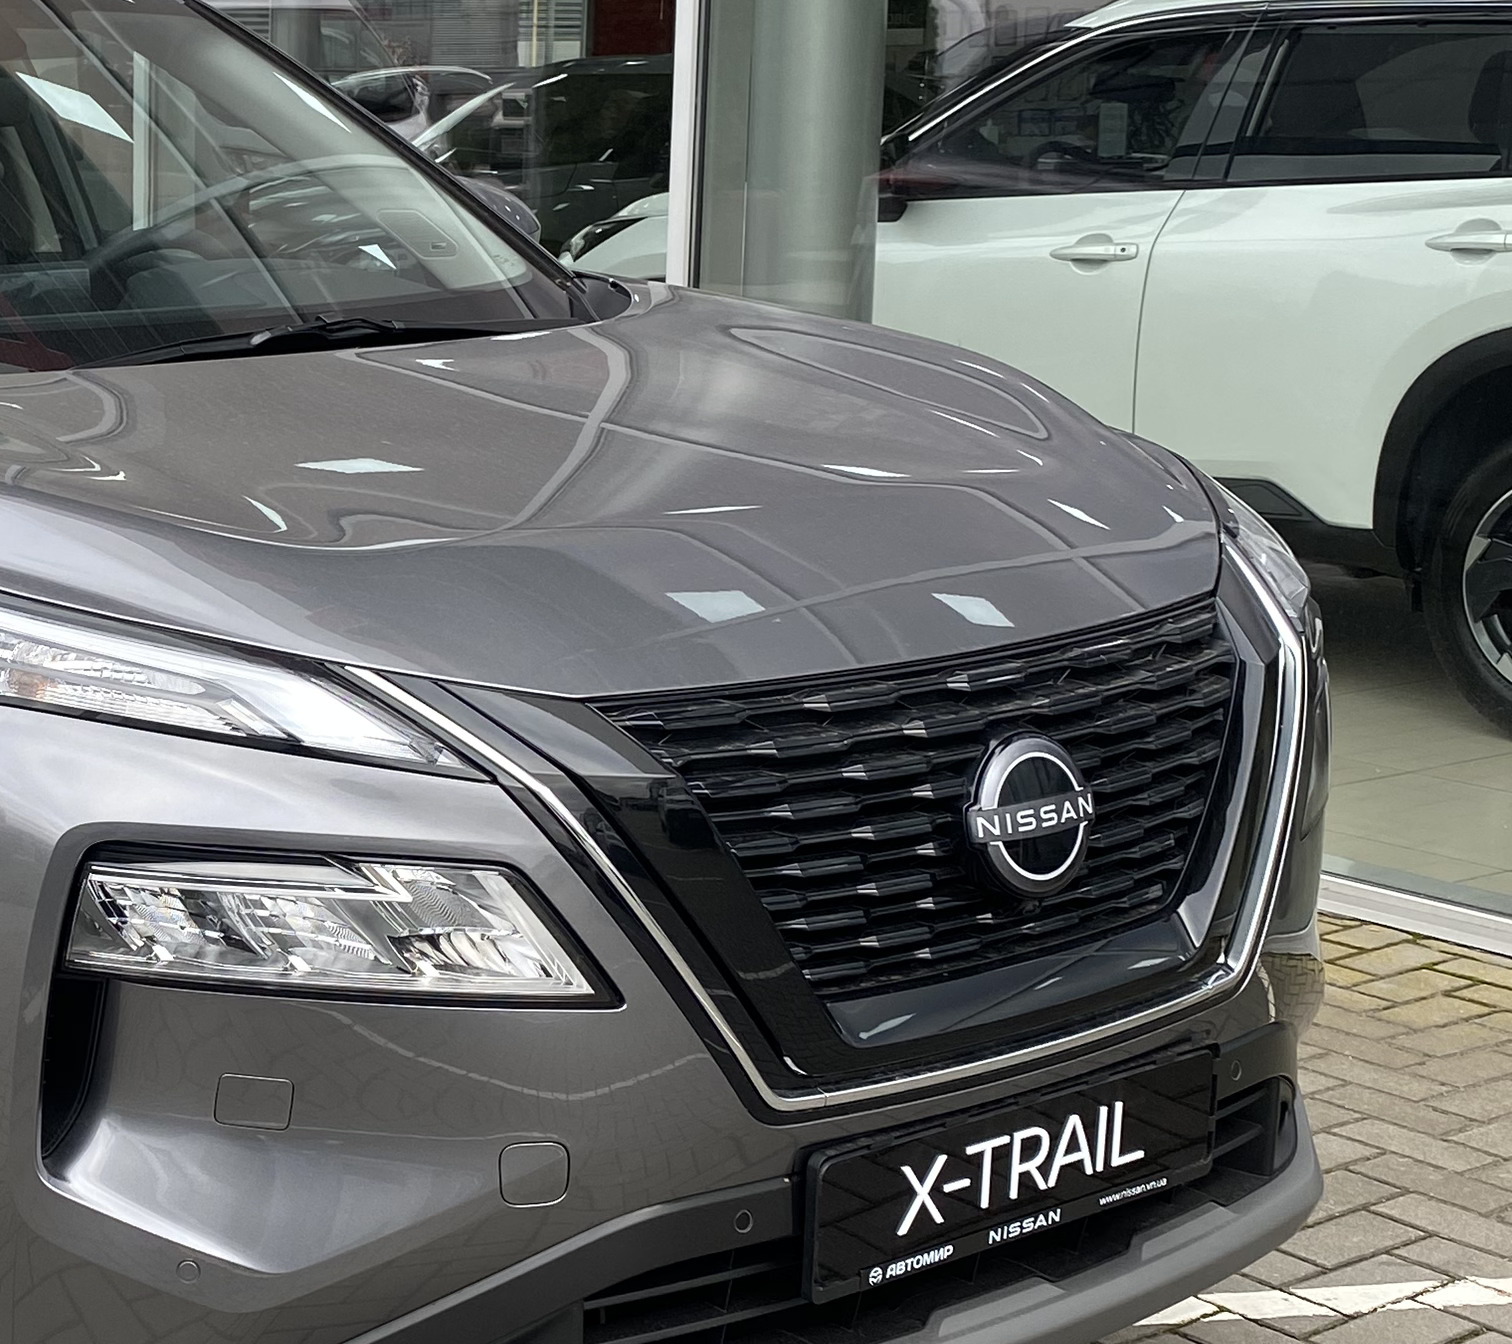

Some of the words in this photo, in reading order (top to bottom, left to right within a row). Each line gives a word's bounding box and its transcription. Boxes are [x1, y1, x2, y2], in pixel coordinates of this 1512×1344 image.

[975, 791, 1095, 840] NISSAN
[896, 1100, 1145, 1237] X-TRAIL
[1098, 1177, 1168, 1206] www.nissan.vn.ua
[988, 1208, 1063, 1244] NISSAN
[885, 1244, 955, 1279] АВТОМИР
